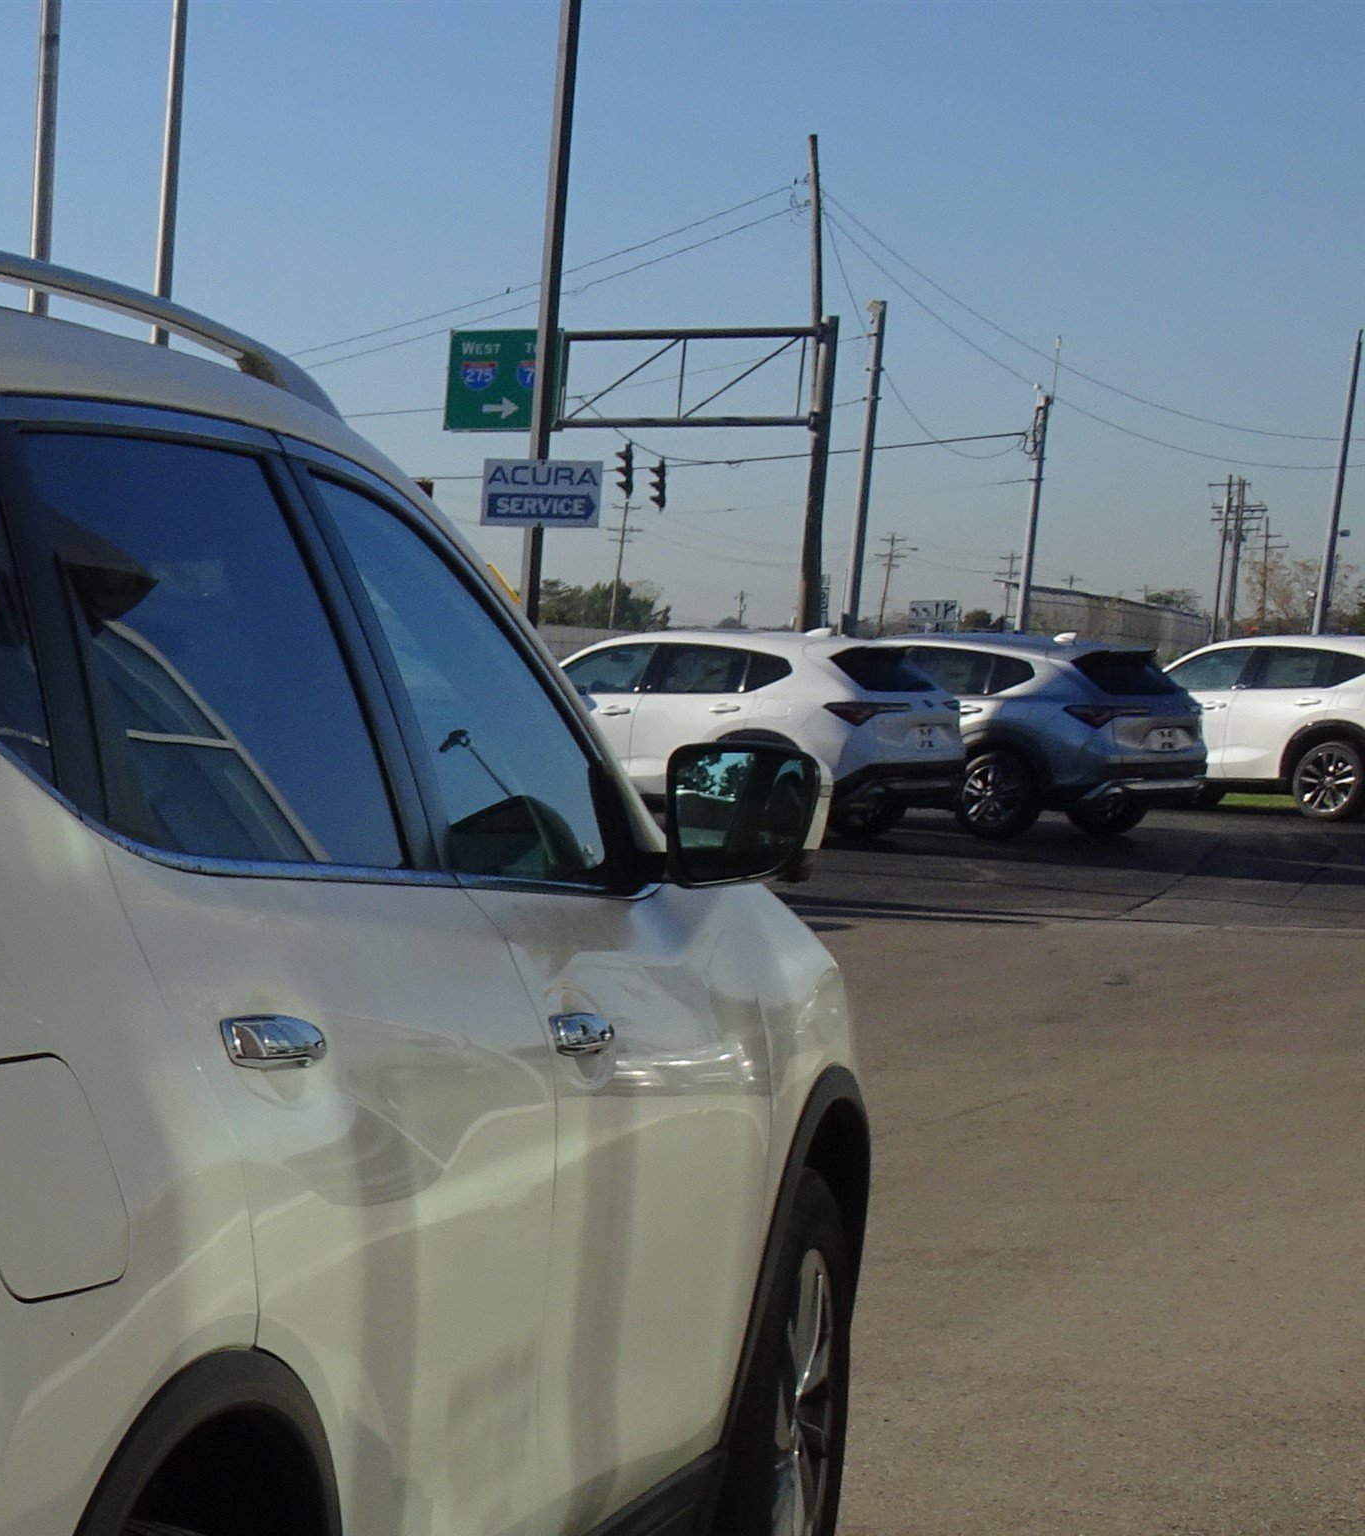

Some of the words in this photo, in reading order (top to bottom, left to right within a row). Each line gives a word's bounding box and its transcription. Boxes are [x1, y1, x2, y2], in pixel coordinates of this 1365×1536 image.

[461, 341, 502, 355] WEST
[524, 342, 537, 354] T
[466, 368, 494, 384] 275
[523, 366, 536, 385] 7
[487, 464, 599, 487] ACURA
[495, 496, 587, 518] SERVICE
